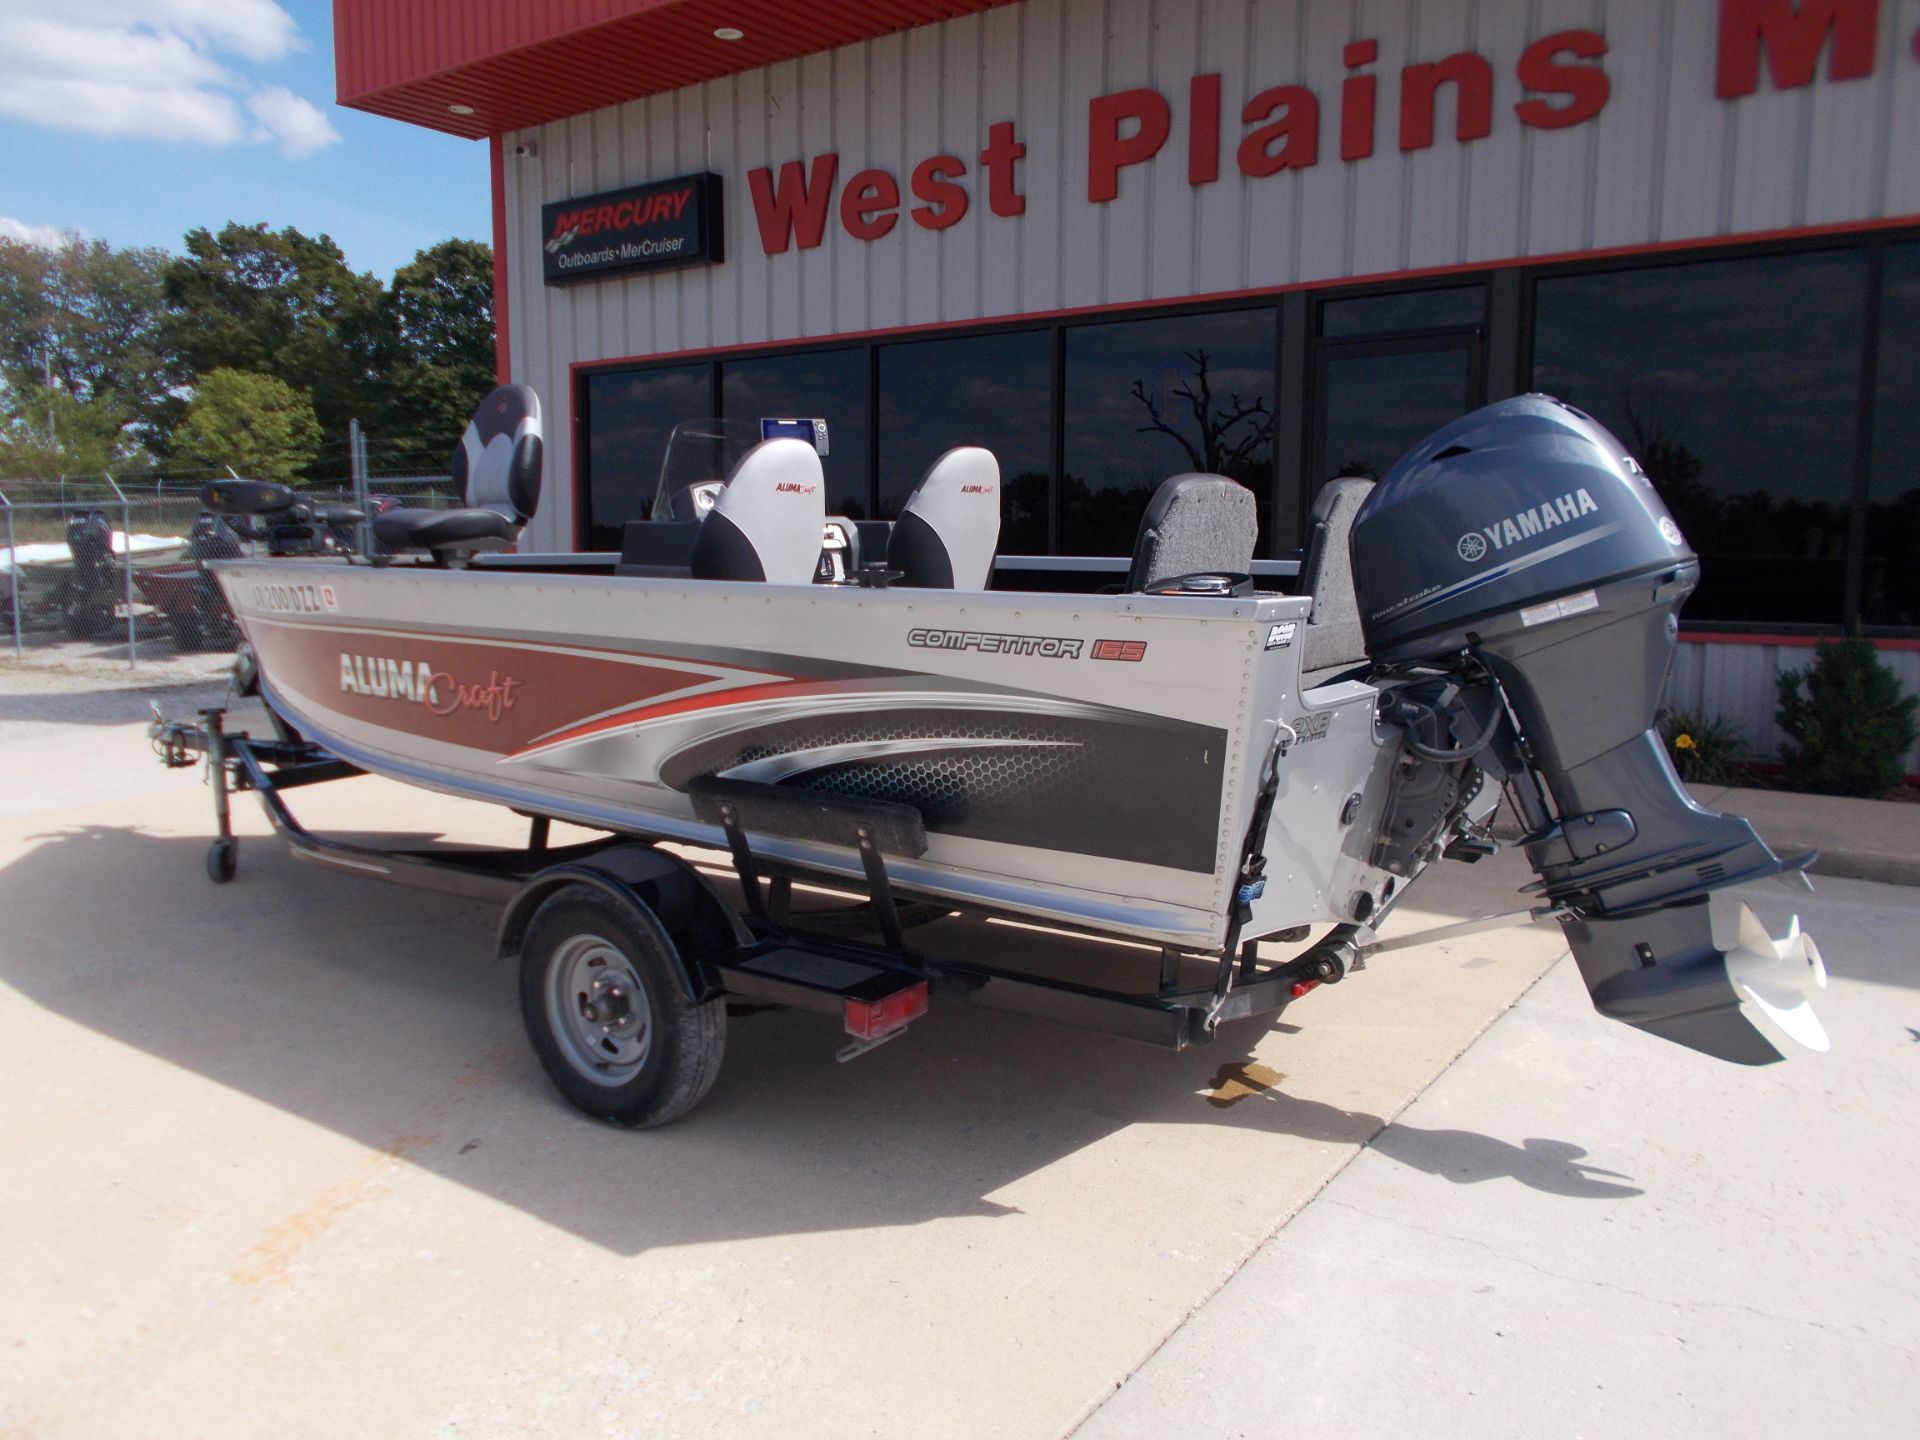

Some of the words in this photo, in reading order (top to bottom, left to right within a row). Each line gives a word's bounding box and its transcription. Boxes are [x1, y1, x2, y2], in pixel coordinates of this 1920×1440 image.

[747, 120, 1026, 254] West
[1088, 29, 1611, 203] Plains
[1715, 0, 1920, 100] M
[553, 189, 692, 238] MERCURY
[620, 238, 684, 259] MerCruiser
[1483, 486, 1599, 550] YAMAHA
[906, 628, 1084, 659] COMPETITOR
[1090, 638, 1148, 662] 165
